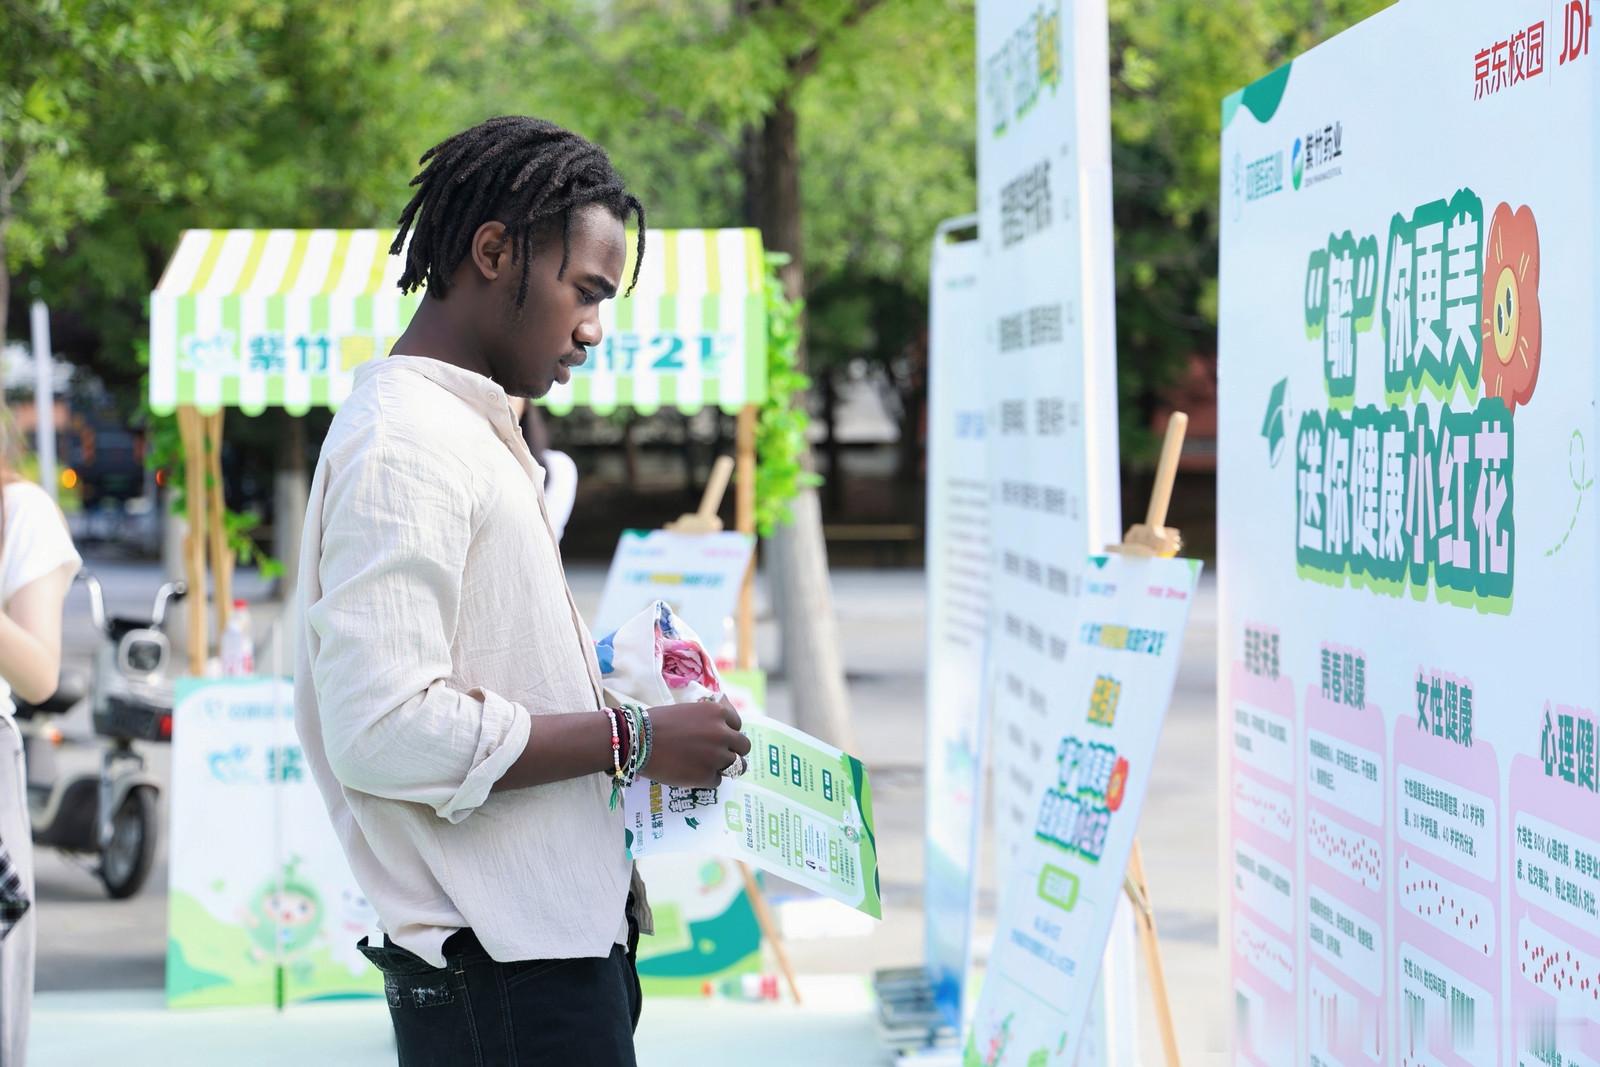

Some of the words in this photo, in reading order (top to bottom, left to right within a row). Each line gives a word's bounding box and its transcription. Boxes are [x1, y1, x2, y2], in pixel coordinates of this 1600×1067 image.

[1474, 20, 1545, 101] 京东校园
[1298, 410, 1511, 586] 送你健康小红花
[1321, 648, 1365, 711] 青春健康
[1416, 672, 1473, 747] 女性健康
[1541, 709, 1600, 793] 心理健
